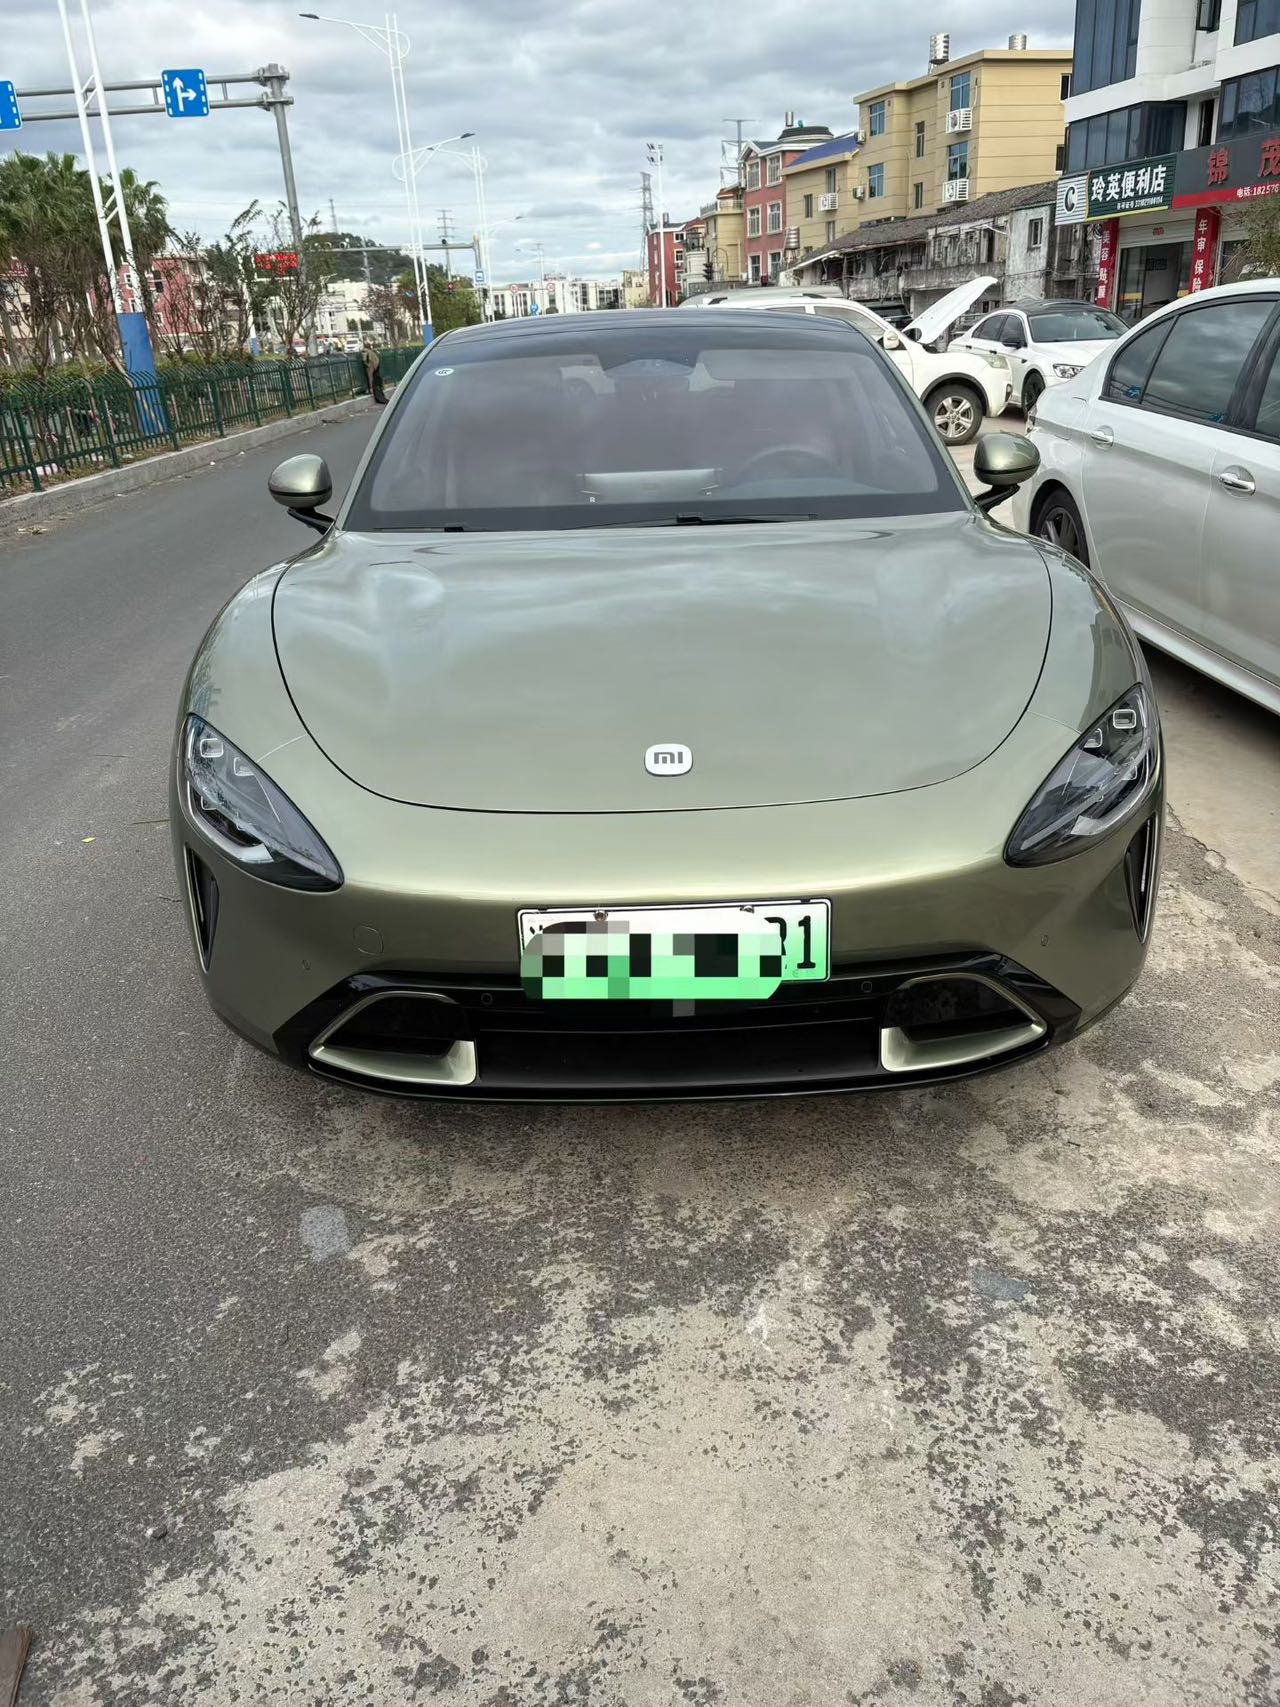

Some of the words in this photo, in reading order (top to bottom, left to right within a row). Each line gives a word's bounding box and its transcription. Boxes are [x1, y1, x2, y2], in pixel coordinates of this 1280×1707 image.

[1091, 164, 1166, 202] 玲英便利店
[1192, 219, 1208, 292] 年审保险
